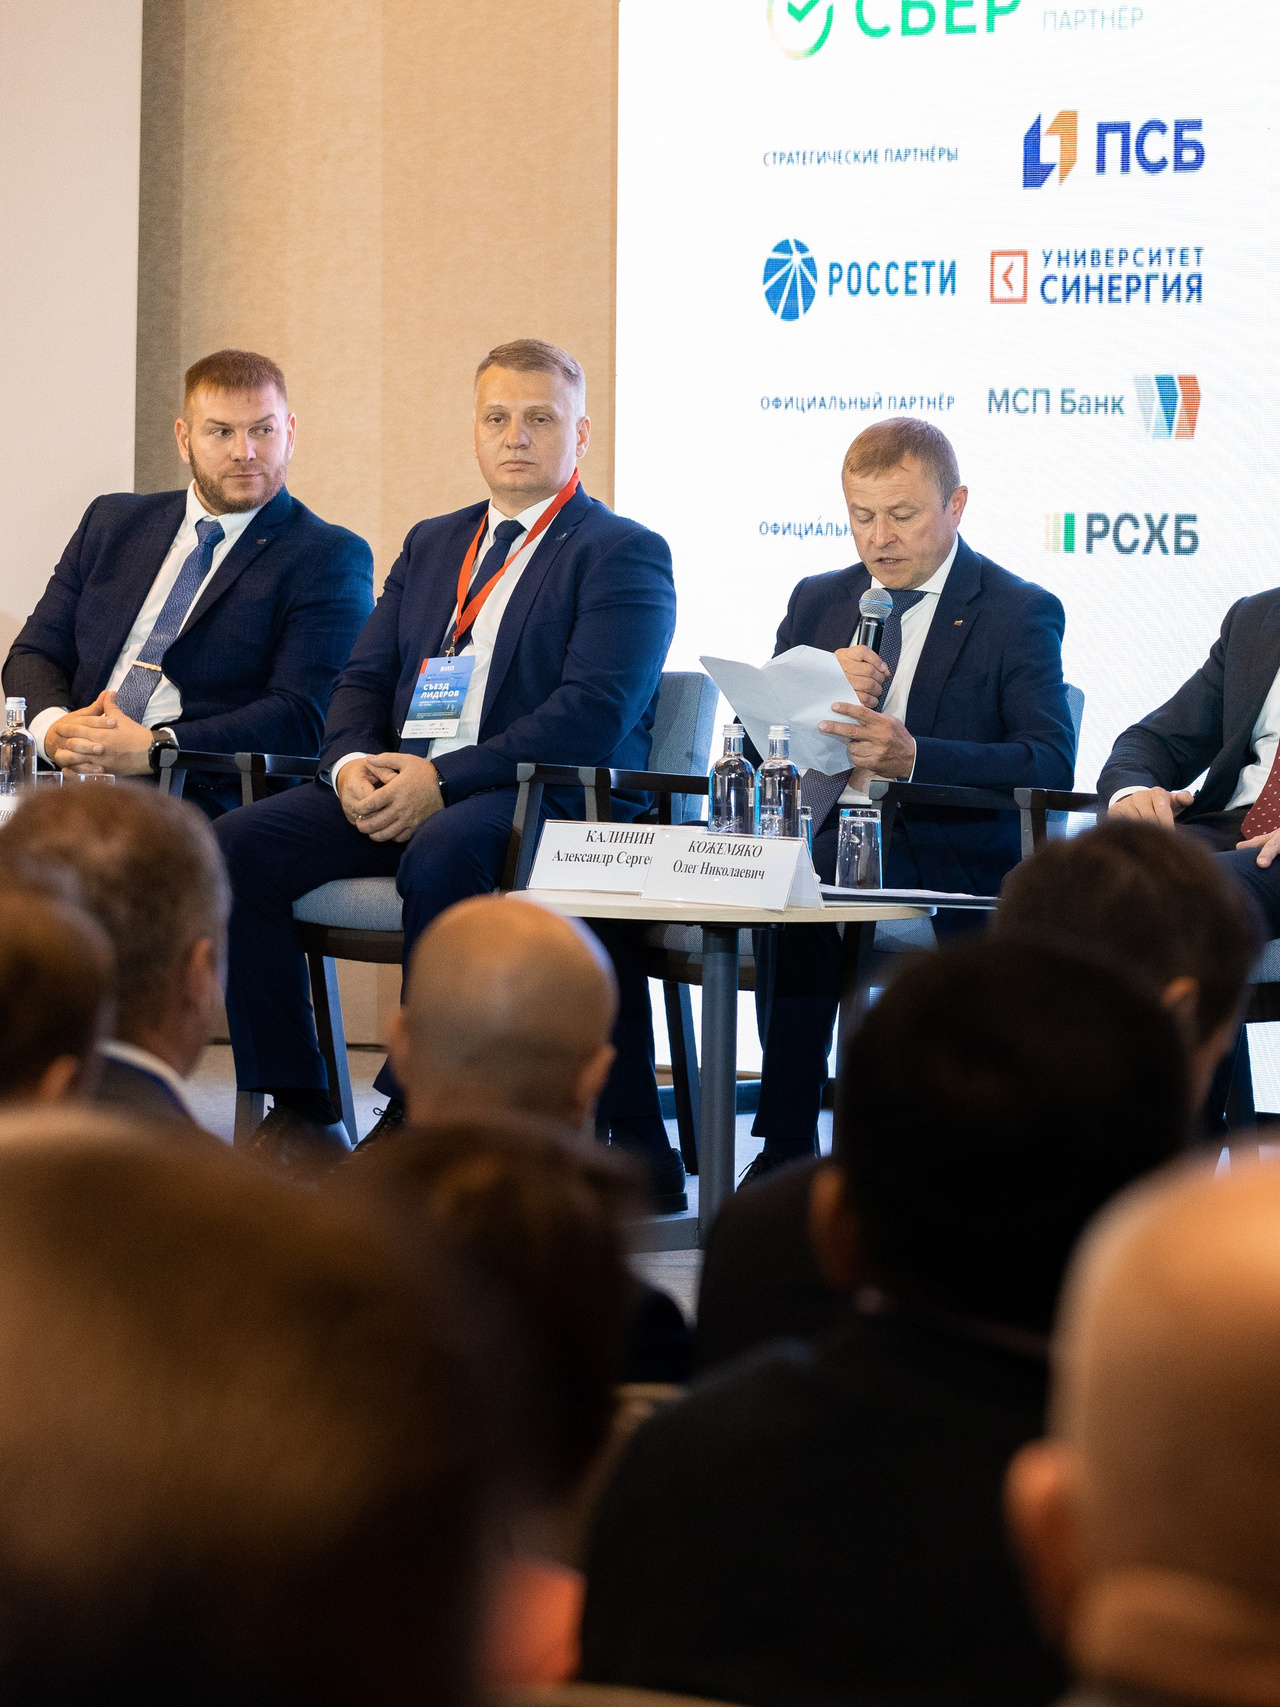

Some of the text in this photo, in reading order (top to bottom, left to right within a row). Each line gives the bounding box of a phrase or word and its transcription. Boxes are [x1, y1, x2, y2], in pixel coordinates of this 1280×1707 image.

[1095, 118, 1206, 175] ПСБ
[762, 148, 879, 167] СТРАТЕГИЧЕСКИЕ
[1041, 246, 1205, 269] УНИВЕРСИТЕТ
[827, 259, 957, 297] РОССЕТИ
[1039, 273, 1204, 306] СИНЕРГИЯ
[760, 392, 883, 413] ОФИЦИАЛЬНЫЙ
[987, 387, 1125, 416] МСП Банк
[1085, 513, 1200, 556] РСХБ
[420, 690, 460, 699] ЛИДЕРОВ
[423, 683, 450, 691] СЪЕЗД
[585, 830, 655, 845] КАЛИНИН
[551, 850, 653, 868] Александр Серге
[687, 840, 763, 858] КОЖЕМЯКО
[673, 859, 765, 880] Олег Николаевич
